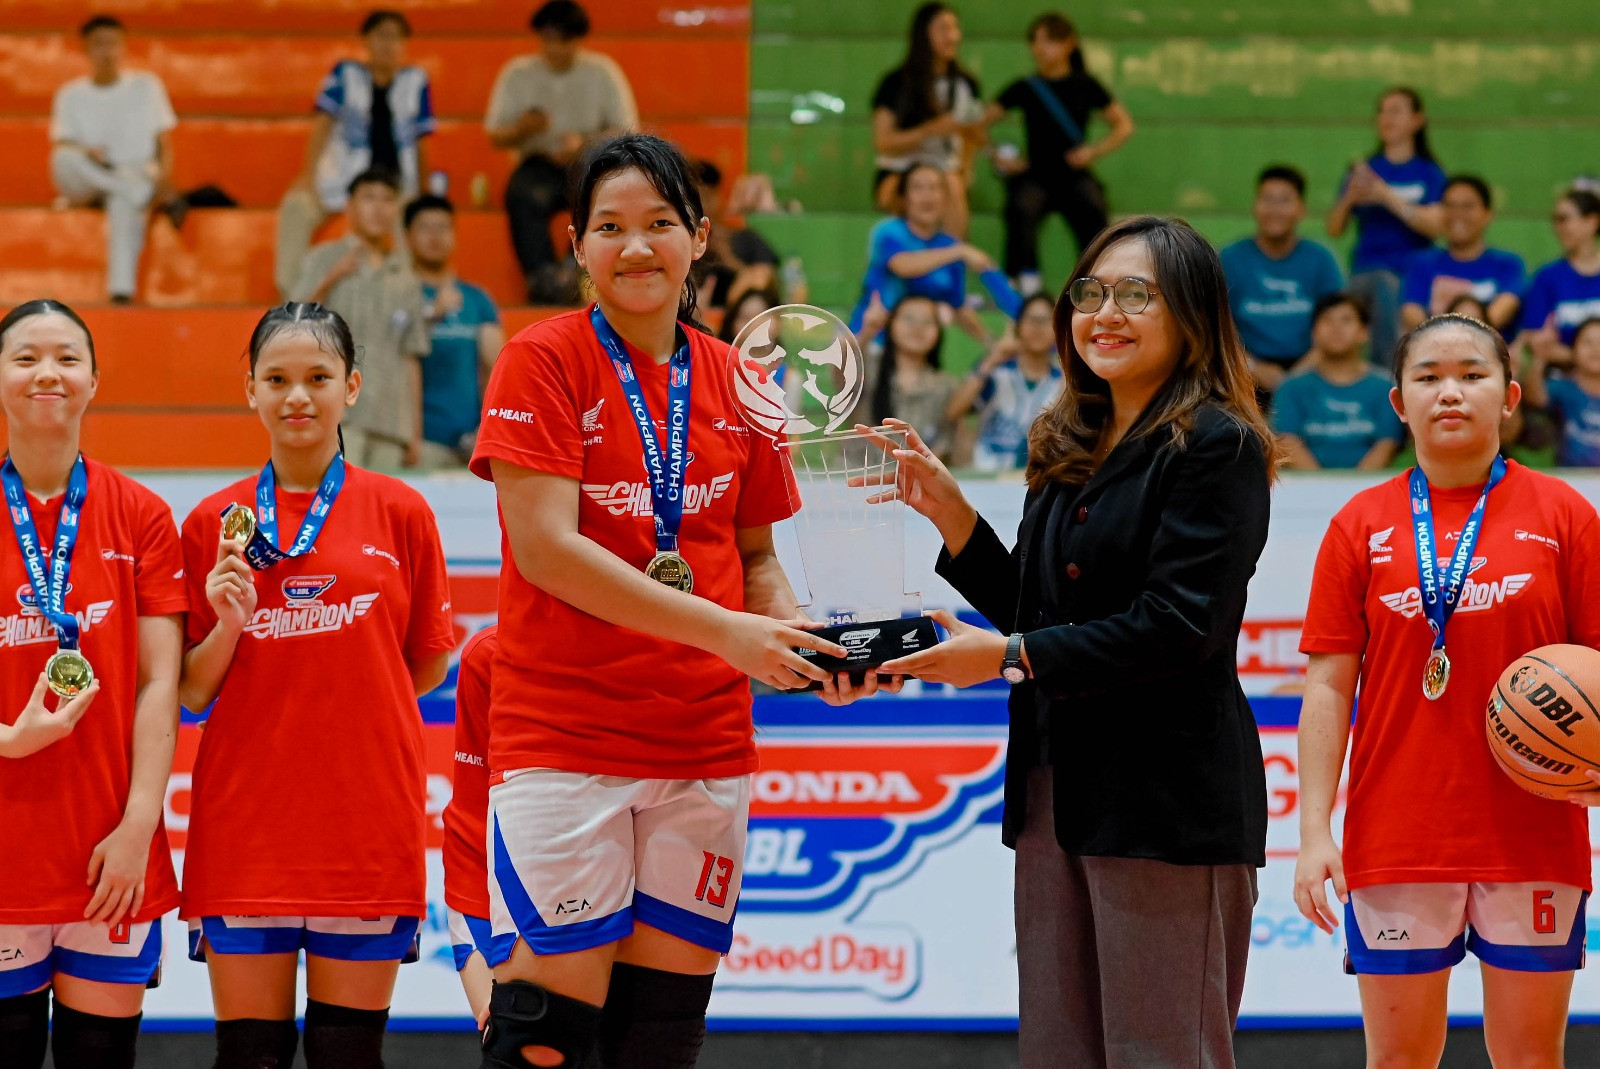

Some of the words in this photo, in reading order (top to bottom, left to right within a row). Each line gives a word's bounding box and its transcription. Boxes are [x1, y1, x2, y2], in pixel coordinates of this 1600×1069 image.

[498, 408, 534, 423] HEART.
[630, 395, 665, 498] CHAMPION
[667, 400, 685, 501] CHAMPION
[21, 533, 50, 613] HAMPION
[52, 535, 69, 613] HAMPION
[1417, 522, 1437, 604] CHAMPION
[1446, 520, 1477, 604] CHAMPION
[243, 592, 380, 640] CHAMPION
[1526, 683, 1584, 737] DBL
[749, 771, 921, 802] ONDA
[695, 851, 734, 908] 13
[745, 828, 813, 876] BL
[1533, 890, 1556, 934] 6
